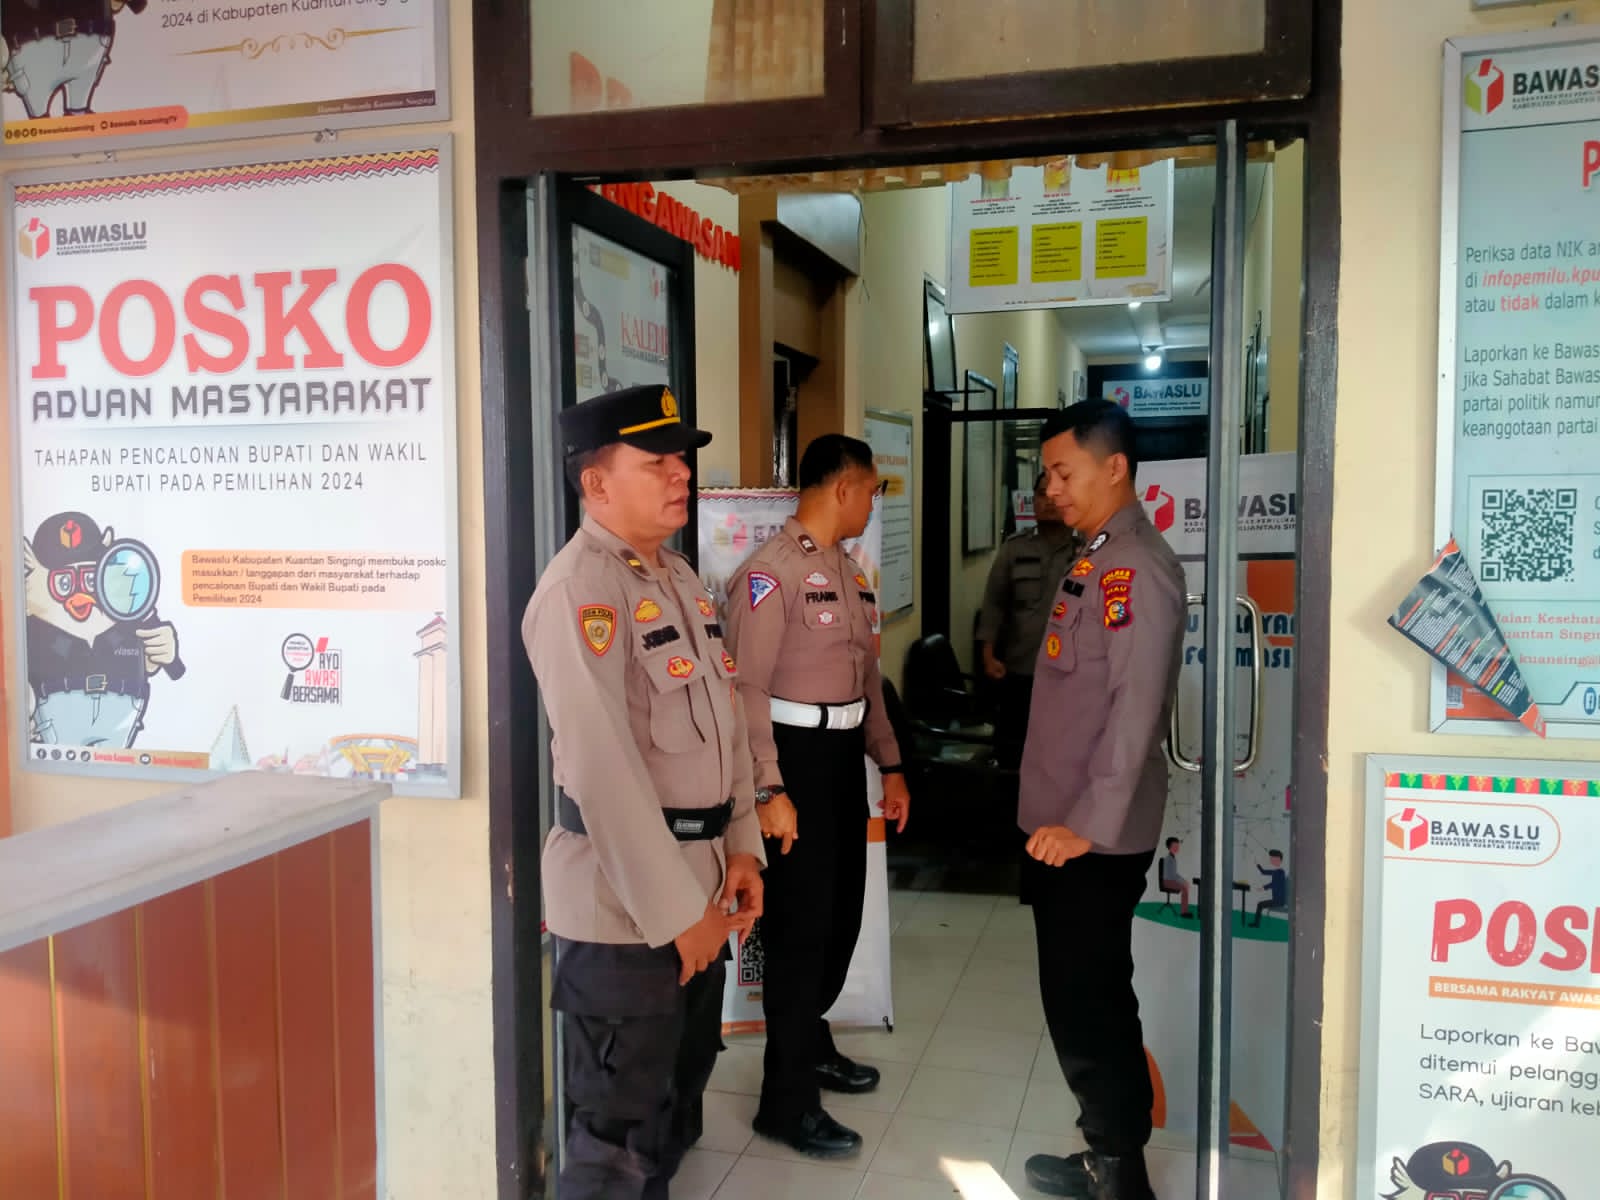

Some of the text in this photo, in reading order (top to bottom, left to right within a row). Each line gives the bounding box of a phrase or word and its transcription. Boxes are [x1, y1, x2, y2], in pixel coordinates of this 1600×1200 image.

[162, 12, 193, 28] 2024
[197, 11, 209, 24] di
[212, 5, 288, 24] Kabupaten
[55, 221, 147, 245] BAWASLU
[583, 181, 741, 272] ENGAWASAN
[1466, 245, 1515, 263] Periksa
[1520, 243, 1551, 259] data
[1557, 241, 1583, 257] NIK
[1465, 273, 1478, 288] di
[1465, 299, 1496, 312] atau
[1501, 295, 1540, 311] tidak
[1544, 293, 1588, 309] dalam
[29, 263, 432, 378] POSKO
[1464, 345, 1528, 366] Laporkan
[1533, 344, 1549, 360] ke
[1463, 373, 1488, 391] jika
[1493, 369, 1550, 386] Sahabat
[32, 376, 432, 422] ADUAN MASYARAKAT
[1463, 398, 1503, 416] partai
[1508, 394, 1550, 413] politik
[1463, 417, 1598, 440] keanggotaan partai
[34, 442, 427, 466] TAHAPAN PENCALONAN BUPATI DAN WAKIL
[91, 471, 364, 493] BUPATI PADA PEMILIHAN 2024
[192, 554, 230, 564] Bawaslu
[232, 554, 283, 566] Kabupaten
[285, 555, 325, 565] Kuantan
[327, 555, 366, 568] Singingi
[368, 557, 415, 566] membuka
[192, 568, 239, 577] masukkan
[246, 568, 296, 580] tanggapan
[298, 569, 317, 578] dari
[318, 570, 375, 581] masyarakat
[376, 570, 421, 582] terhadap
[192, 581, 386, 595] pencalonan Bupati dan Wakil Bupati pada
[192, 594, 263, 604] Pemilihan 2024
[1503, 629, 1553, 640] uantan
[319, 653, 339, 670] AYO
[305, 669, 339, 688] AWASI
[292, 686, 339, 704] BERSAMA
[1431, 820, 1540, 840] BAWASLU
[1434, 982, 1499, 997] BERSAMA
[1501, 986, 1556, 1001] RAKYAT
[1420, 1023, 1520, 1048] Laporkan
[1531, 1032, 1554, 1050] ke
[1419, 1054, 1497, 1076] ditemui
[1419, 1083, 1484, 1107] SARA,
[1491, 1091, 1564, 1113] ujiaran
